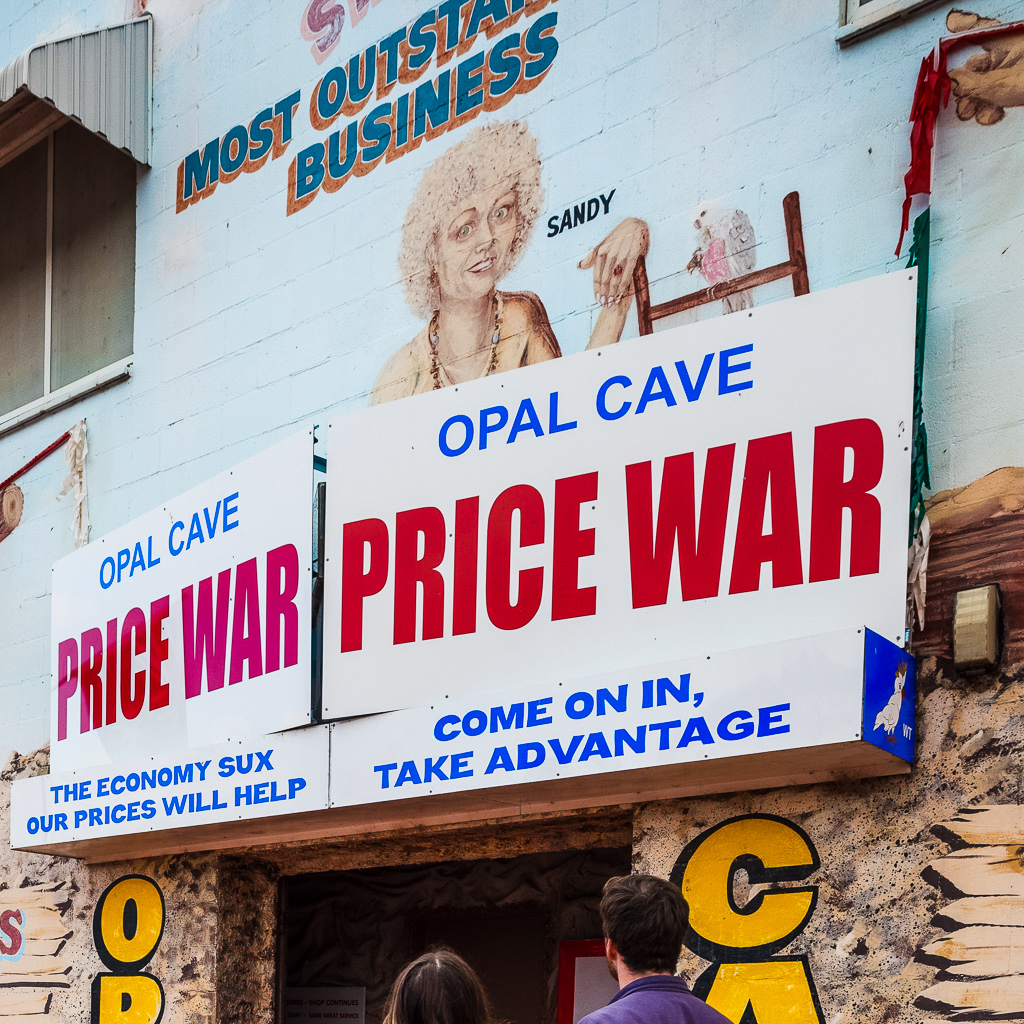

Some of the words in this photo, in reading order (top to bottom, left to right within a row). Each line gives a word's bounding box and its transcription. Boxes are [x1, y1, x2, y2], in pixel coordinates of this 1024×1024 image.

[178, 90, 301, 210] MOST
[288, 12, 559, 214] BUSINESS
[547, 189, 617, 238] SANDY
[438, 391, 578, 458] OPAL
[595, 343, 755, 421] CAVE
[99, 547, 161, 590] OPAL
[168, 491, 240, 557] CAVE
[340, 470, 599, 654] PRICE
[625, 417, 885, 610] WAR
[57, 594, 170, 742] PRICE
[181, 543, 300, 700] WAR
[373, 750, 474, 790] TAKE
[483, 702, 791, 775] ADVANTAGE
[433, 696, 553, 742] COME
[564, 684, 628, 720] ON
[641, 672, 705, 708] IN,
[26, 812, 69, 835] OUR
[74, 799, 157, 829] PRICES
[162, 789, 228, 816] WILL
[234, 777, 308, 807] HELP
[50, 780, 92, 804] THE
[96, 760, 213, 798] ECONOMY
[217, 749, 275, 778] SUX
